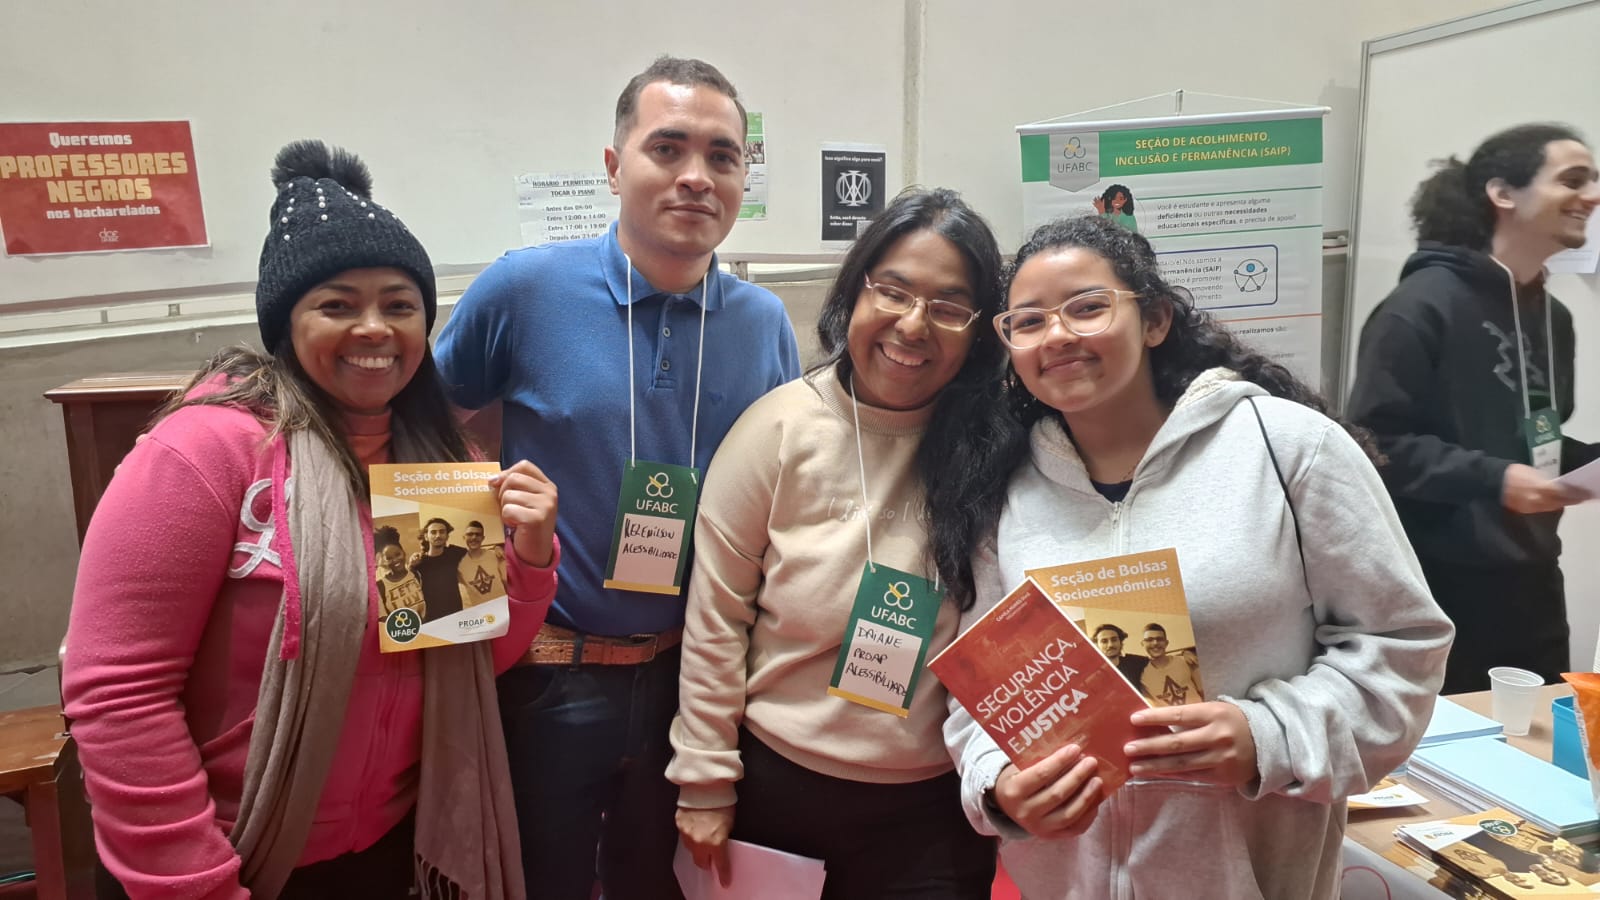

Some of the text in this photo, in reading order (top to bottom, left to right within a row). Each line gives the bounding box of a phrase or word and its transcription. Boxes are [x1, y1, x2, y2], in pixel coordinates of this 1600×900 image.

[49, 132, 133, 148] Queremos
[1135, 132, 1270, 150] SEÇÃO DE ACOLHIMENTO,
[1115, 146, 1291, 166] INCLUSÃO E PERMANÊNCIA (SAIP)
[0, 152, 188, 179] PROFESSORES
[1057, 161, 1094, 174] UFABC
[46, 178, 153, 204] NEGROS
[46, 204, 161, 219] nos bacharelados
[1178, 201, 1210, 209] estudante
[1216, 199, 1247, 208] apresenta
[1157, 211, 1192, 220] deficiência
[1224, 207, 1268, 216] necessidades
[1157, 221, 1200, 230] educacionais
[393, 469, 493, 484] Seção de Bolsas
[394, 483, 493, 497] Socioeconômica
[636, 498, 679, 514] UFABC
[1051, 560, 1168, 588] Seção de Bolsas
[1054, 577, 1172, 603] Socioeconômicas
[458, 618, 485, 629] PROAP
[871, 605, 917, 630] UFABC
[391, 627, 417, 638] UFABC
[976, 637, 1078, 720] SEGURANÇA,
[990, 664, 1080, 735] VIOLÊNCIA
[1007, 688, 1089, 755] E JUSTIÇA
